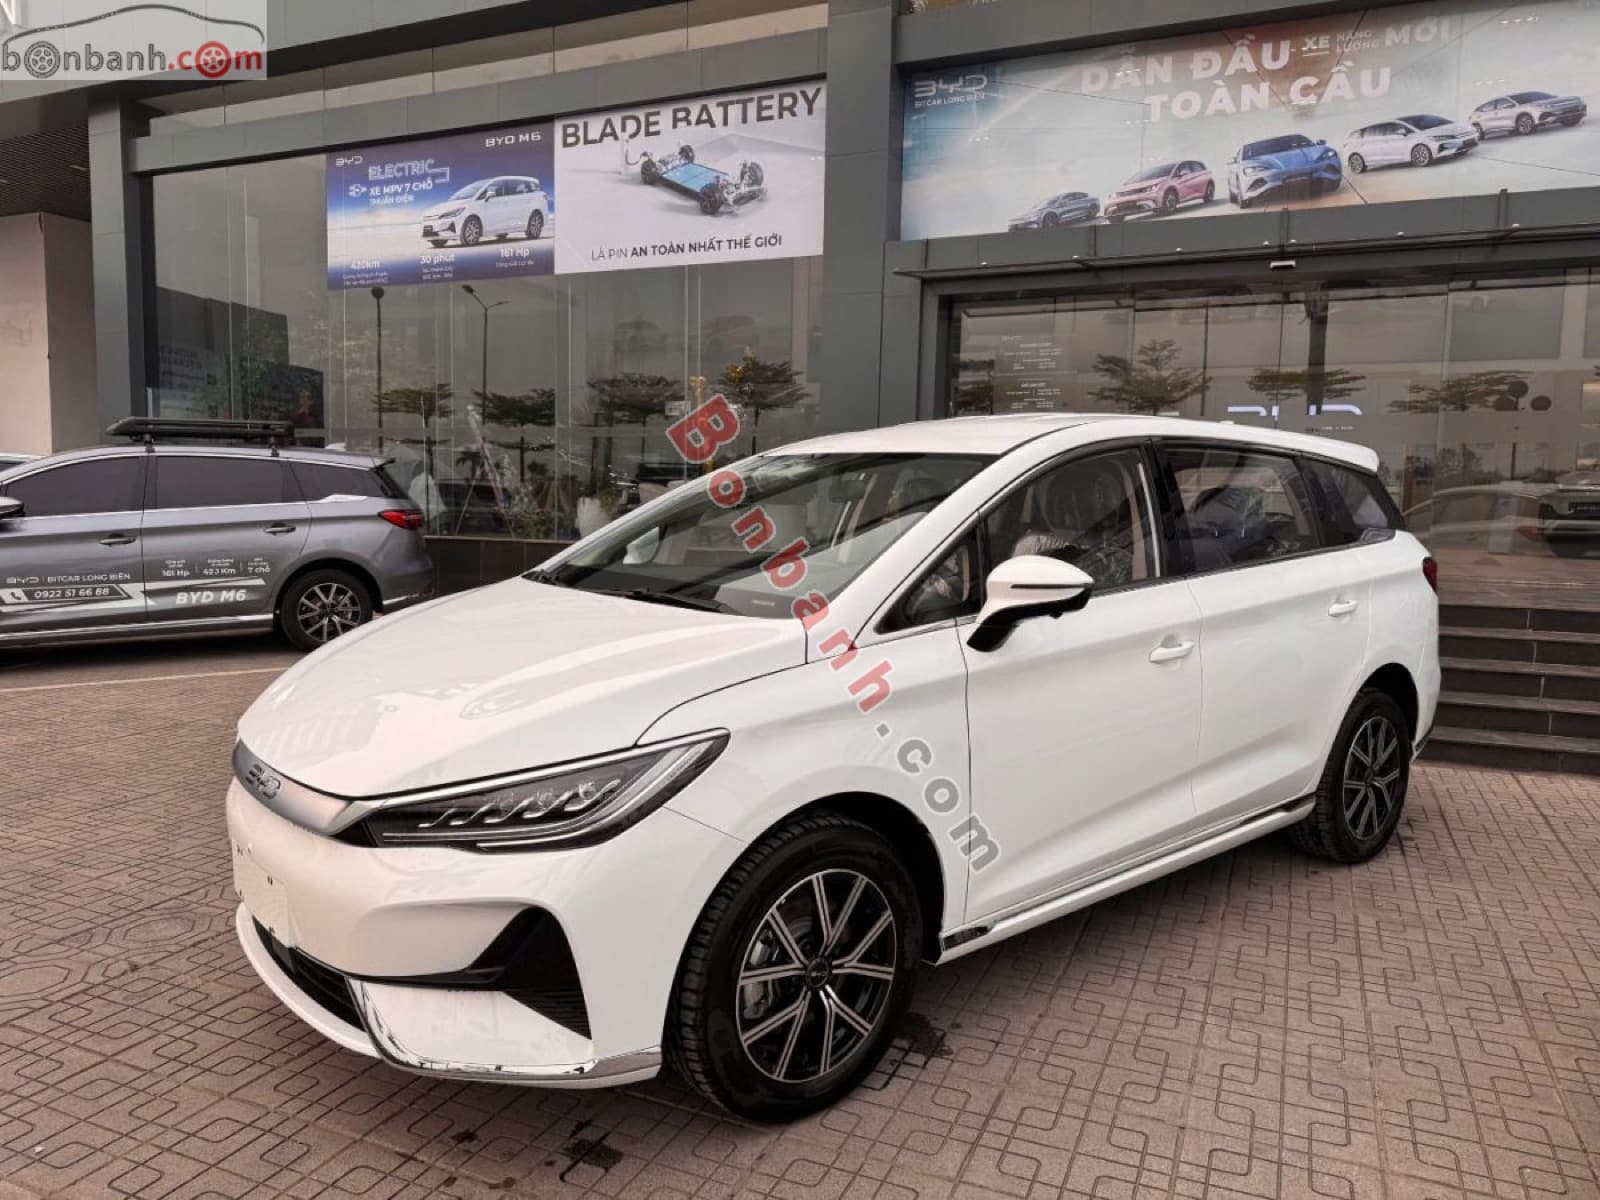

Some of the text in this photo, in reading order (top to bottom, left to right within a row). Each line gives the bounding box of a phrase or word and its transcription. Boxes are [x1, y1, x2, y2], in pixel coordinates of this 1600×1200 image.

[1384, 16, 1450, 47] MỚI
[1189, 35, 1291, 80] ĐẦU
[1303, 35, 1331, 50] XE
[1144, 60, 1392, 122] TOÀN CẦU
[561, 87, 822, 148] BLADE BATTERY
[485, 131, 542, 147] BYD M6
[367, 158, 435, 181] ELECTRIC
[369, 185, 382, 197] XE
[404, 182, 412, 193] 7
[591, 232, 782, 261] LÀ PIN AN TOÀN NHẤT THẾ GIỚI
[420, 255, 432, 265] 30
[82, 573, 108, 582] LONG
[34, 590, 62, 600] 0922
[175, 588, 248, 605] BYD M6
